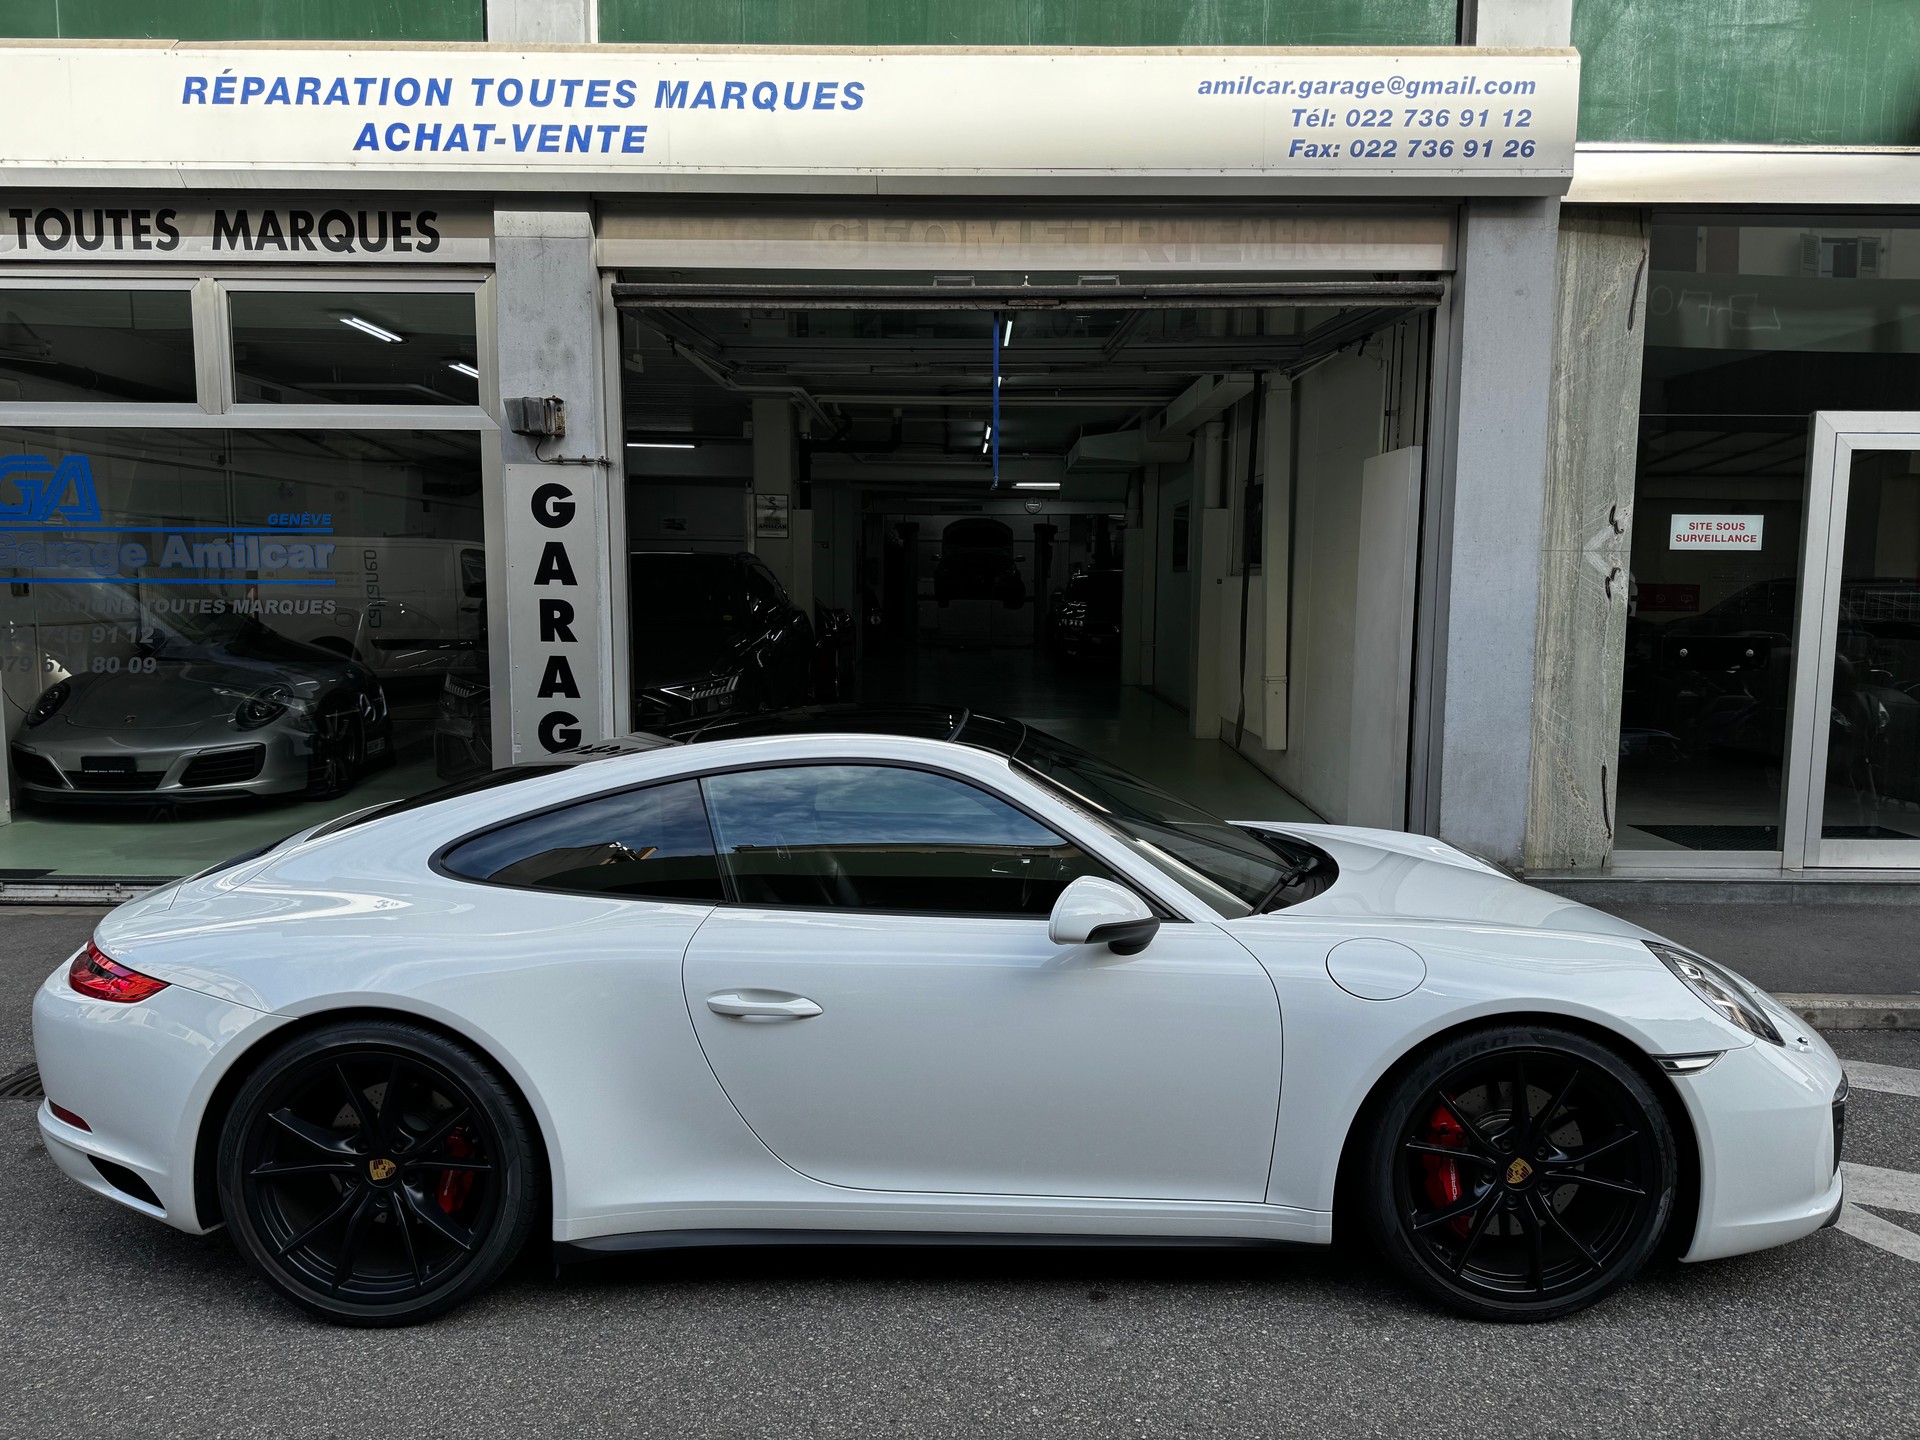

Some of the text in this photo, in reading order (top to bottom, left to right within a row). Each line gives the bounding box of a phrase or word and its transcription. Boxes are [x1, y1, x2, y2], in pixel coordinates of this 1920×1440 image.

[182, 68, 865, 111] RÉPARATION TOUTES MARQUES
[1198, 75, 1536, 98] amilcar.garage@gmail.com
[1291, 107, 1533, 128] Tél: 022 736 91 12
[353, 122, 648, 153] ACHAT-VENTE
[1289, 139, 1536, 159] Fax: 022 736 91 26
[9, 208, 440, 254] TOUTES MARQUES
[267, 511, 332, 526] GENÈVE
[1688, 522, 1745, 531] SITE SOUS
[1675, 534, 1757, 542] SURVEILLANCE
[159, 534, 336, 569] Amilcar
[150, 599, 226, 614] TOUTES
[232, 599, 337, 615] MARQUES
[530, 482, 583, 755] GARAG
[91, 626, 119, 644] 91
[126, 626, 155, 644] 12
[91, 656, 121, 674] 80
[127, 656, 157, 674] 09
[1449, 1158, 1458, 1202] PORSCH
